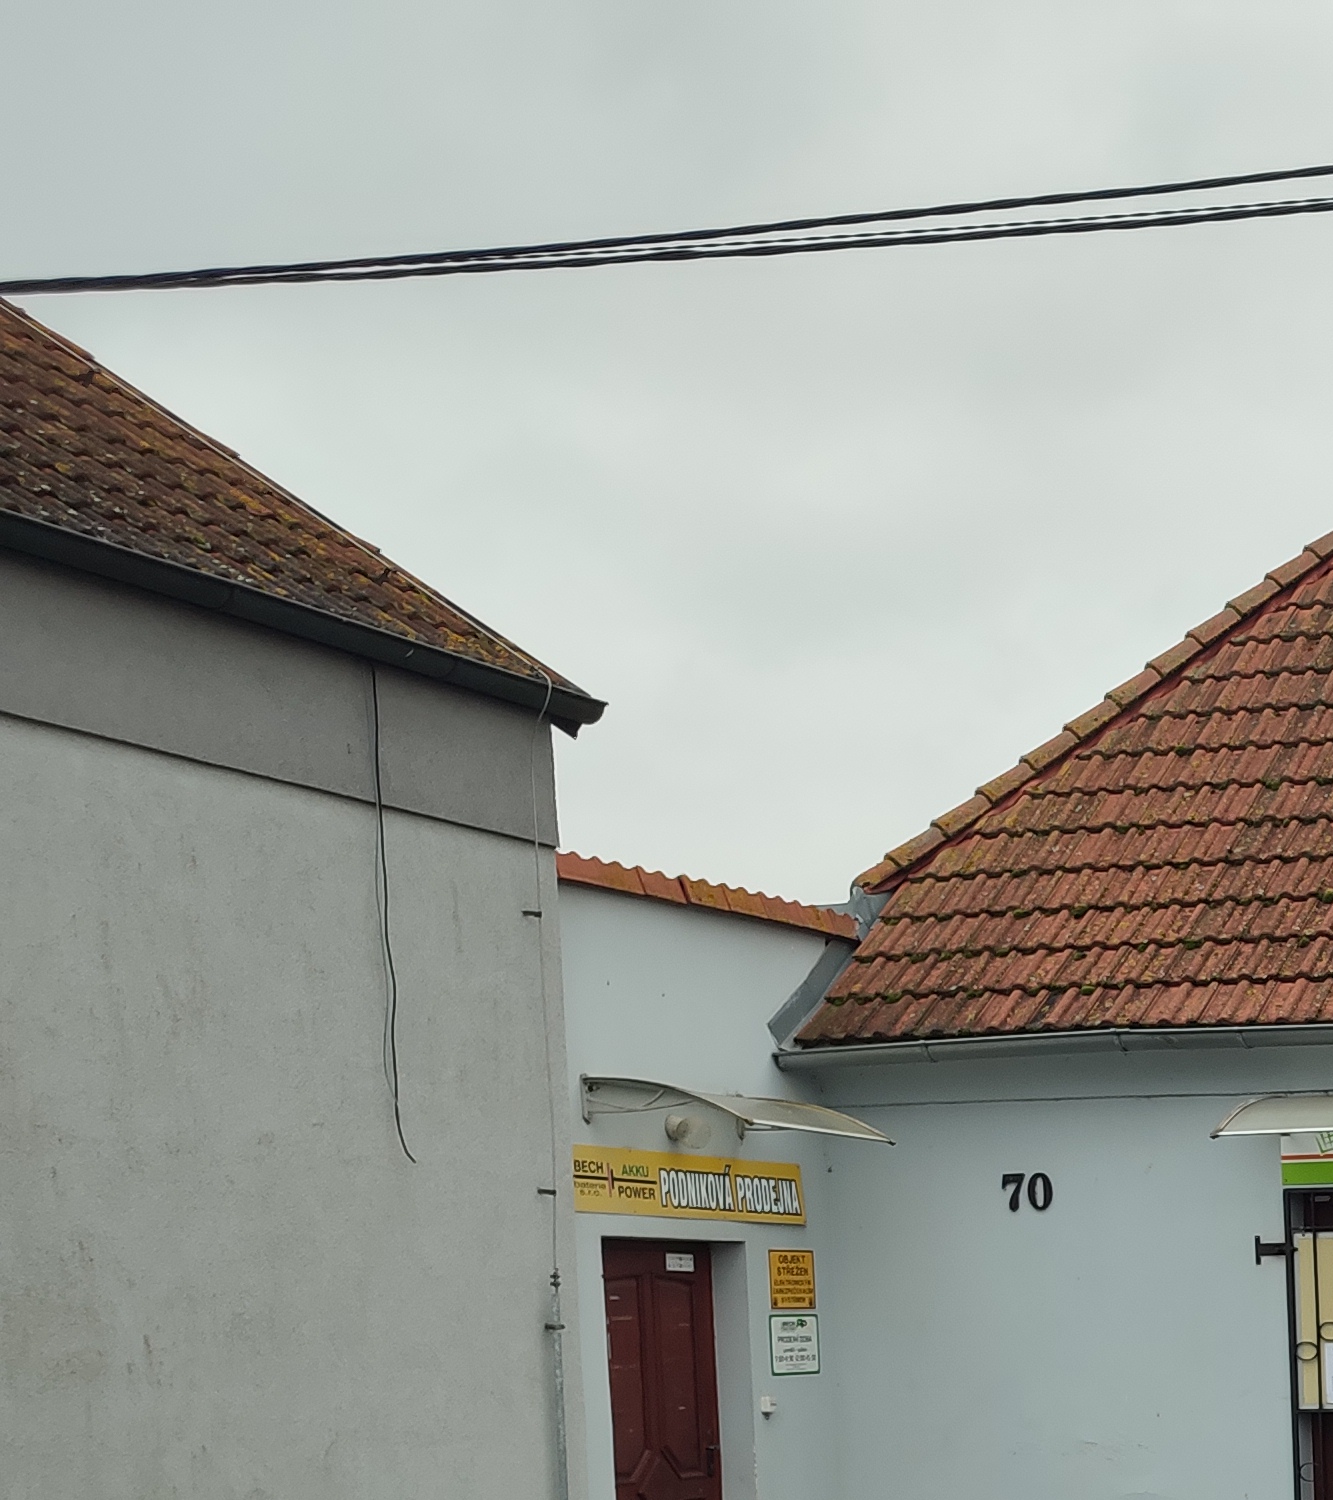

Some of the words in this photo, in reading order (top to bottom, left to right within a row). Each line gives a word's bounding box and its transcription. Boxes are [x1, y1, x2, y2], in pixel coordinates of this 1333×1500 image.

[573, 1159, 604, 1174] BECH
[621, 1164, 649, 1177] AKKU
[618, 1186, 656, 1200] POWER
[659, 1164, 736, 1212] PODNIKOVÁ
[735, 1174, 802, 1216] PRODEJNA
[1001, 1172, 1053, 1212] 70
[778, 1254, 806, 1264] OBJEKT
[776, 1265, 809, 1276] STŘEŽEN
